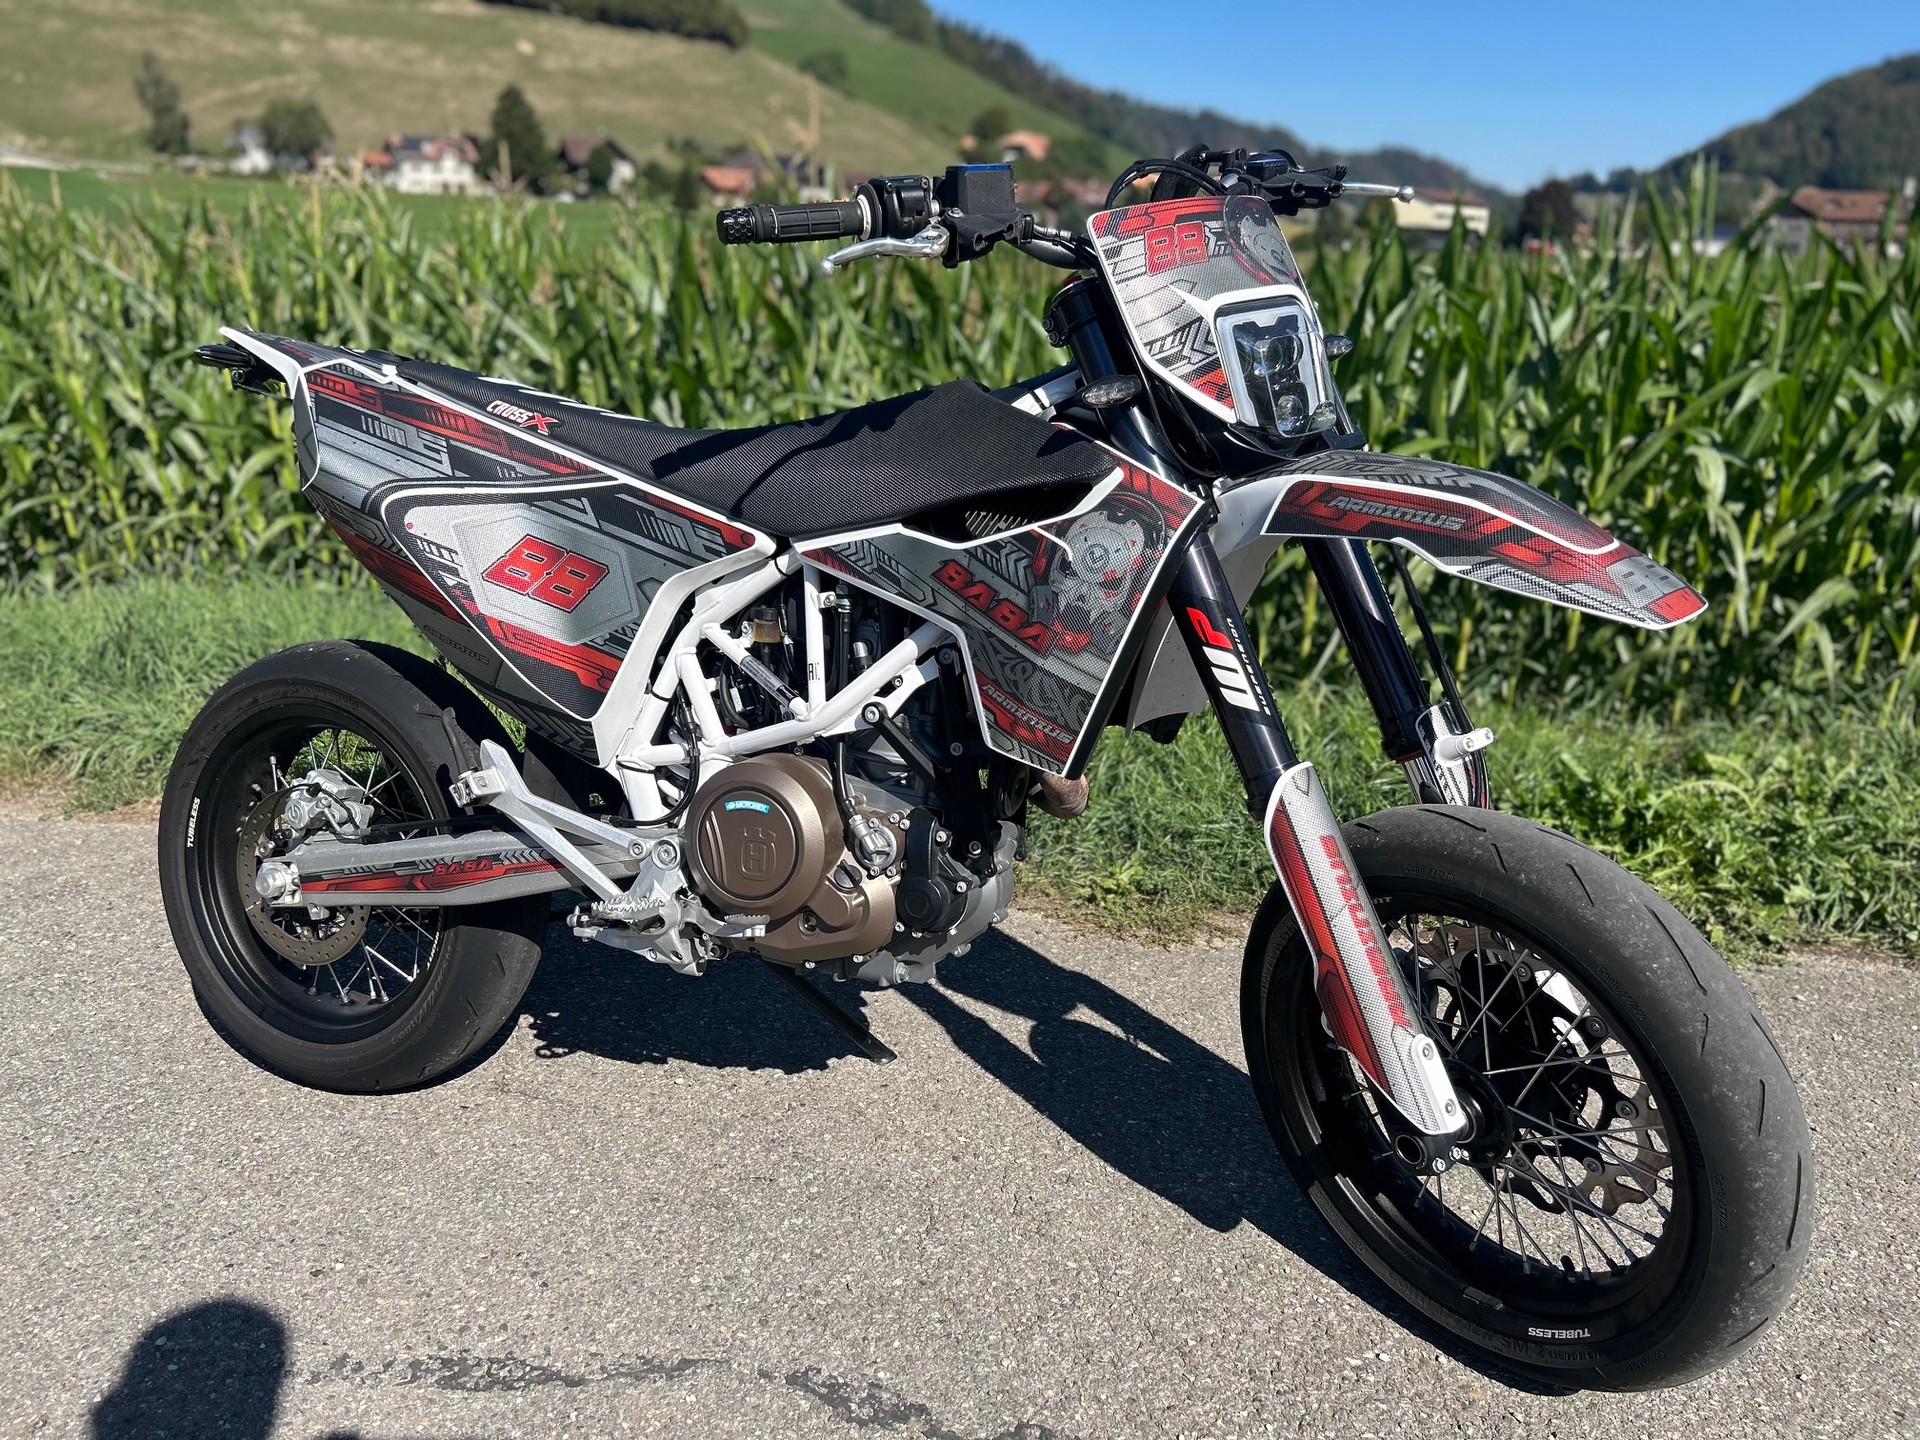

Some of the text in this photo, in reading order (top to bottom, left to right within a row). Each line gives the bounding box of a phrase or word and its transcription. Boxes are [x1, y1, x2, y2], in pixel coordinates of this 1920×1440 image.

[1144, 220, 1209, 277] 88
[1327, 496, 1467, 532] ARMINIUS
[482, 534, 610, 613] 88
[930, 559, 1059, 655] BABA
[1225, 618, 1271, 717] SUSPENSION
[982, 683, 1074, 745] ARMINIUS
[187, 797, 201, 849] TUBELESS
[432, 858, 494, 877] BABA
[1528, 1325, 1593, 1338] TUBELESS
